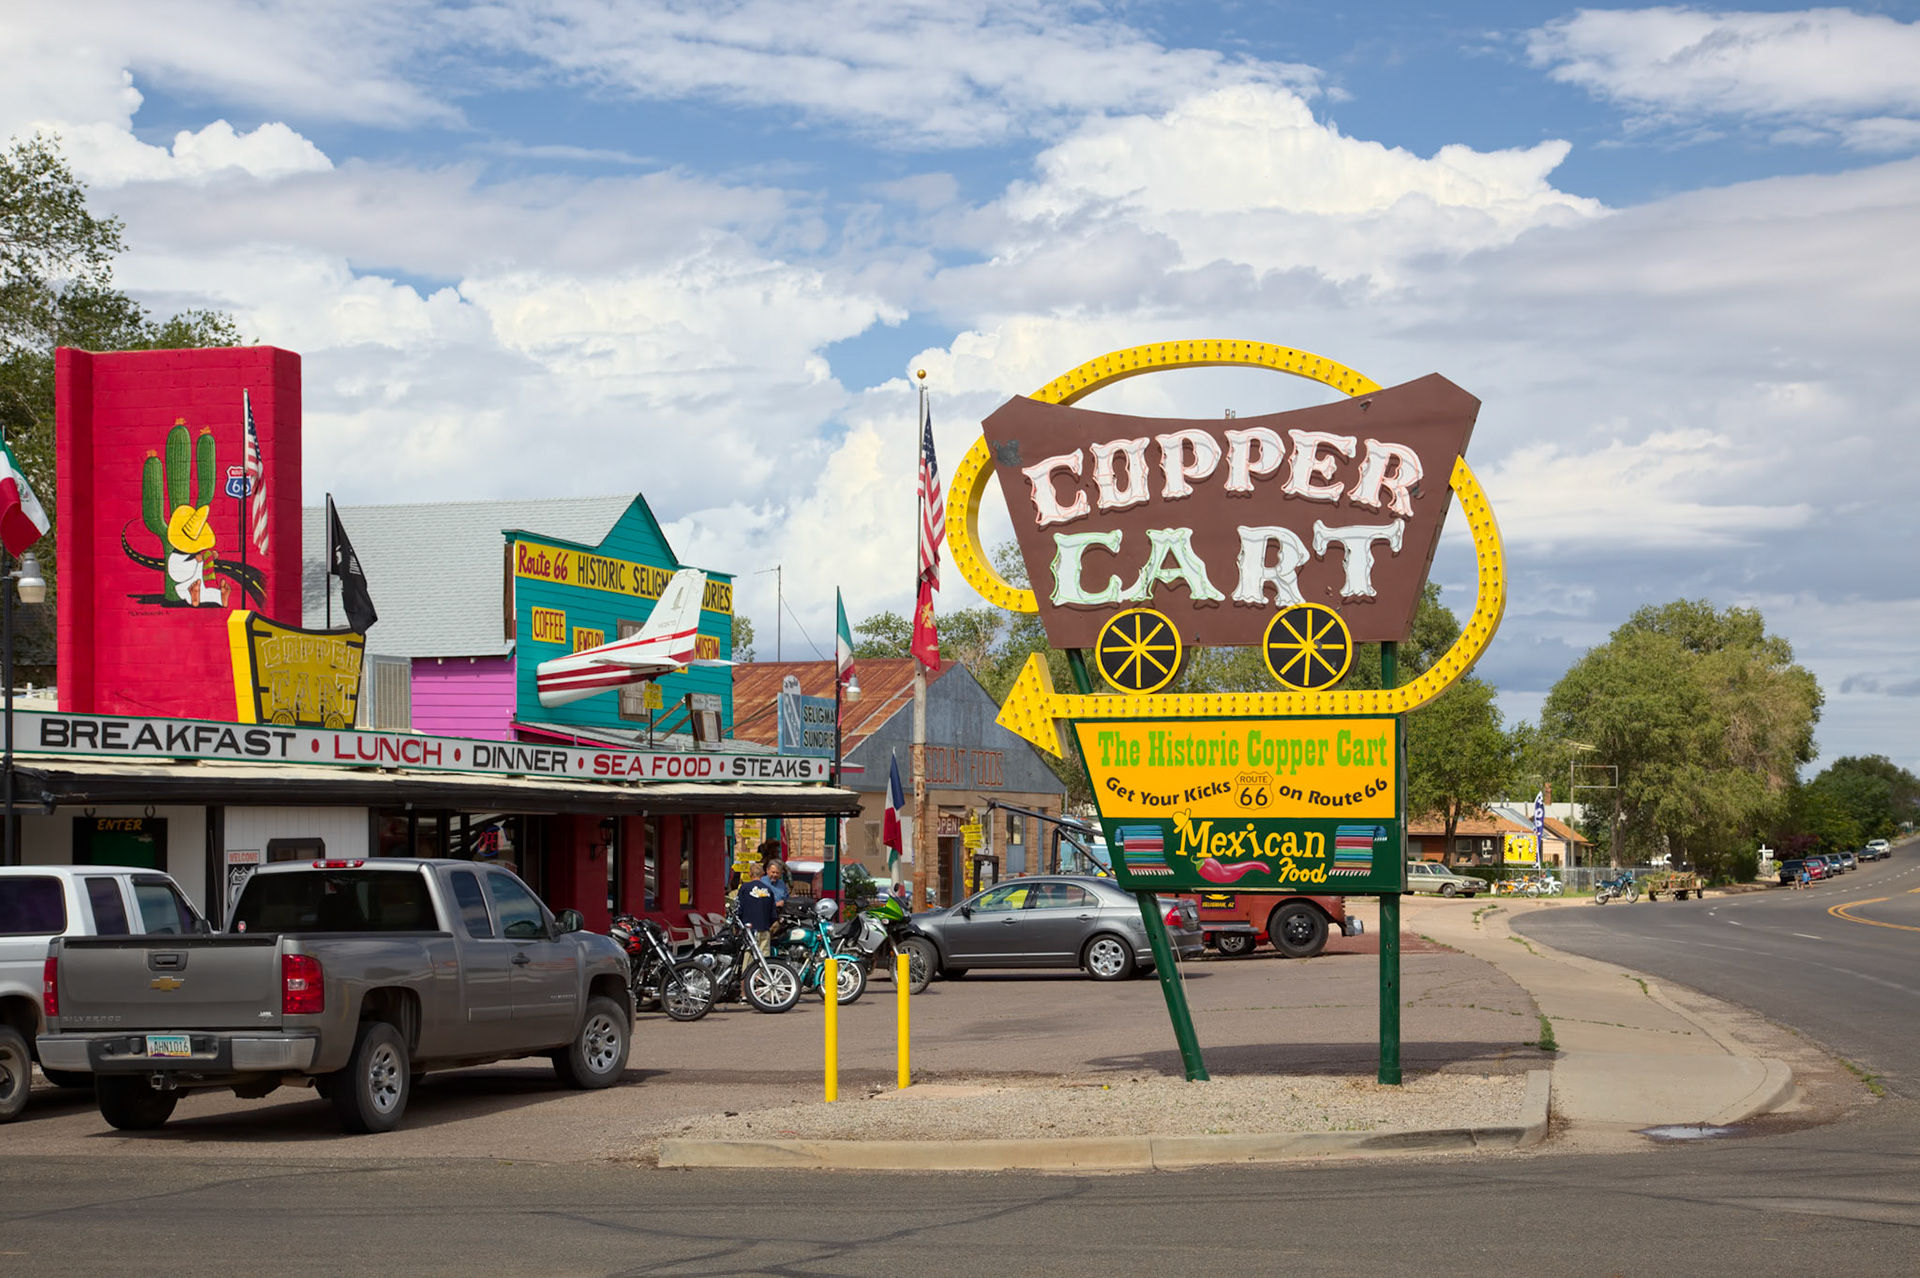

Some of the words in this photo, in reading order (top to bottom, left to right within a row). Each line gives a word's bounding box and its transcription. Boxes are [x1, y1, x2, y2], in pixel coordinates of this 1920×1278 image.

[1021, 426, 1424, 525] COPPER
[518, 544, 550, 577] Route
[553, 552, 569, 581] 66
[577, 554, 625, 591] HISTORIC
[633, 565, 673, 597] SELIGM
[1050, 519, 1405, 607] CART
[533, 609, 565, 641] COFFEE
[261, 635, 362, 676] COPPER
[270, 669, 356, 717] CART
[803, 705, 836, 725] SELIGMA
[40, 718, 296, 757] BREAKFAST
[334, 735, 442, 765] LUNCH
[472, 745, 568, 773] DINNER
[593, 754, 644, 776] SEA
[651, 757, 711, 777] FOOD
[732, 757, 811, 778] STEAKS
[803, 731, 836, 749] SUNDRIE
[1098, 731, 1140, 766] The
[1148, 730, 1239, 766] Historic
[1247, 730, 1329, 775] Copper
[1336, 729, 1388, 767] Cart
[909, 744, 966, 786] SCOUNT
[971, 750, 1004, 788] FOODS
[1240, 775, 1268, 784] ROUTE
[1106, 776, 1136, 802] Get
[1140, 791, 1180, 807] Your
[1184, 780, 1231, 803] Kicks
[1239, 787, 1268, 806] 66
[1279, 784, 1303, 801] on
[1308, 790, 1363, 807] Route
[1364, 777, 1388, 799] 66
[97, 818, 142, 831] ENTER
[1173, 814, 1326, 858] Mexican
[229, 852, 258, 863] WELCOME
[1279, 857, 1328, 883] Food
[154, 1041, 189, 1053] AHN1016
